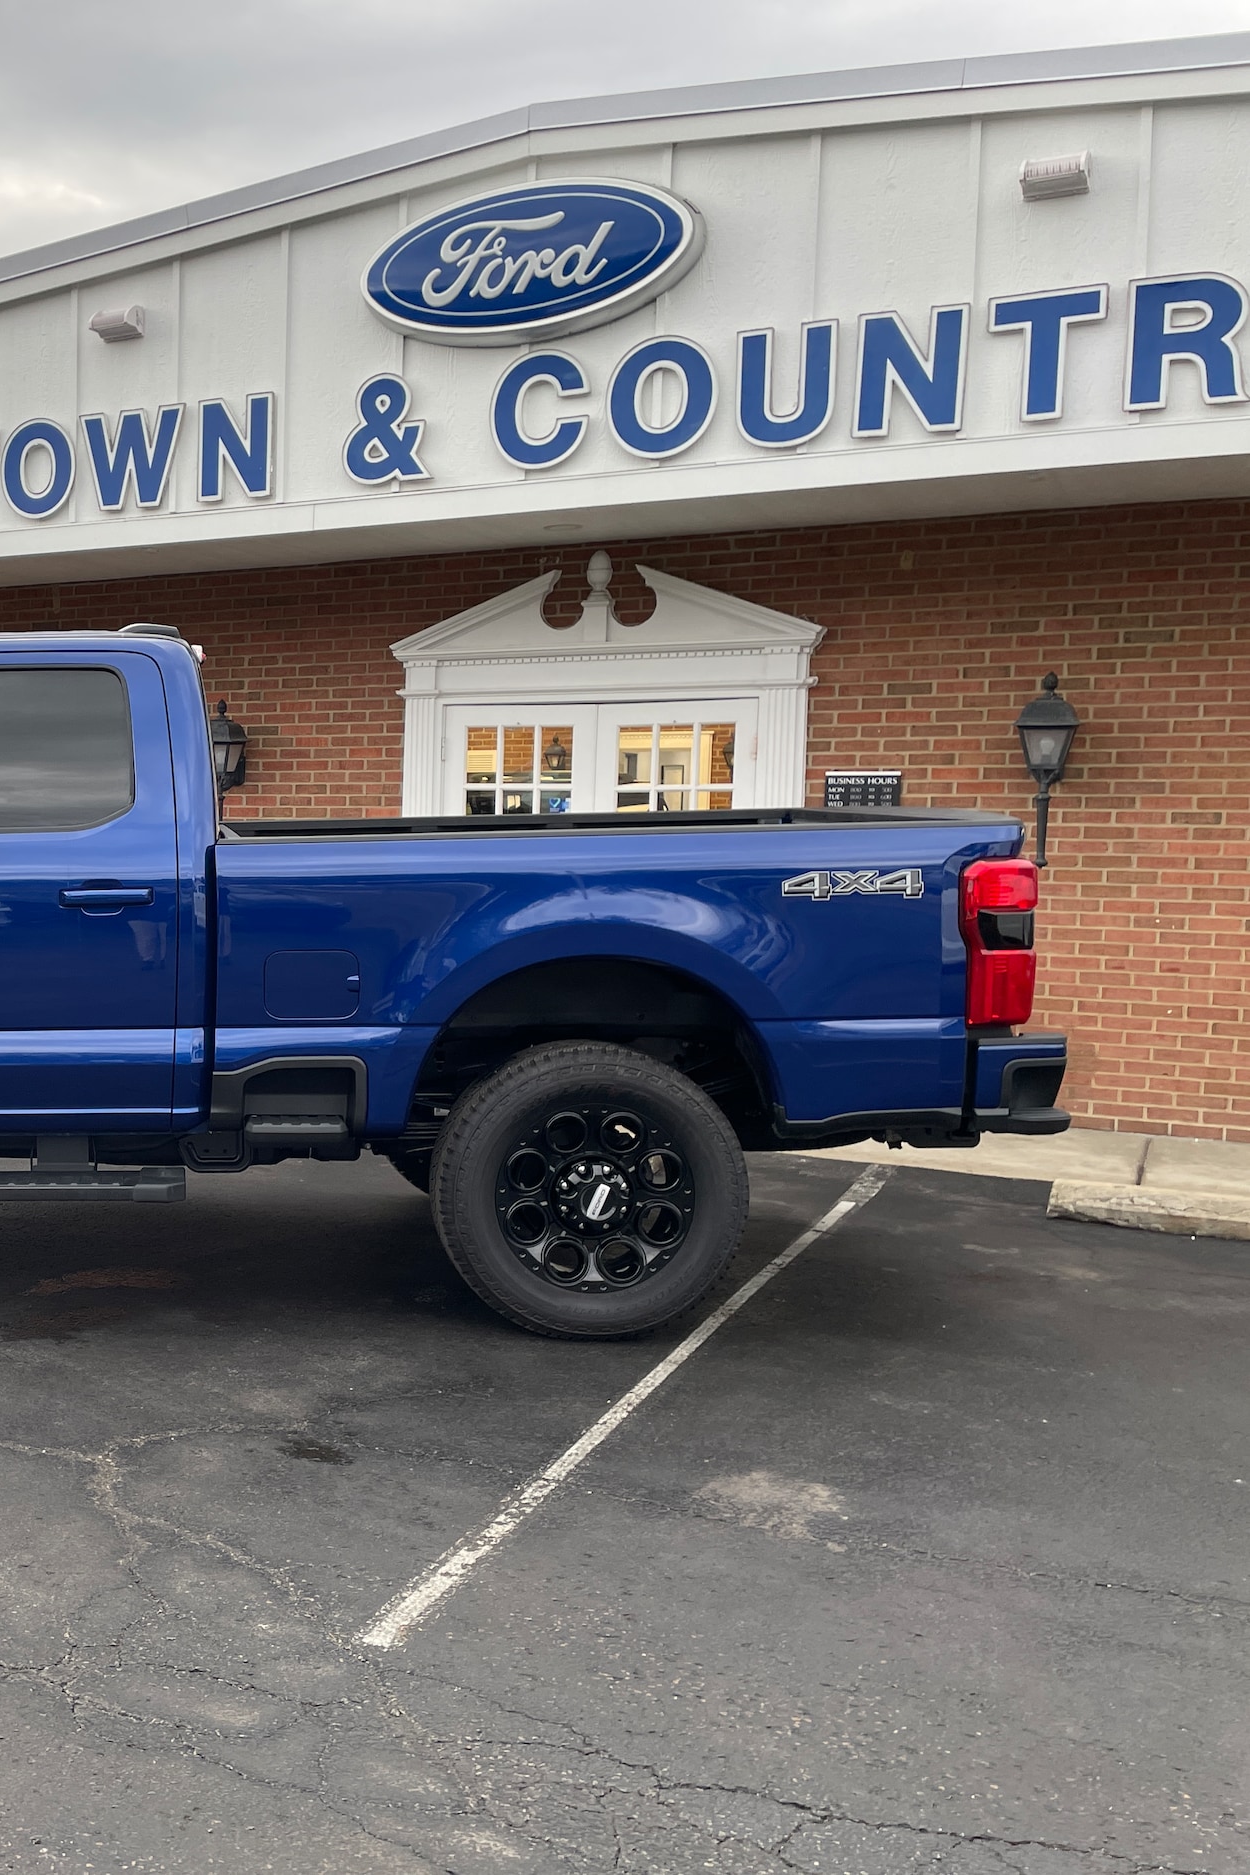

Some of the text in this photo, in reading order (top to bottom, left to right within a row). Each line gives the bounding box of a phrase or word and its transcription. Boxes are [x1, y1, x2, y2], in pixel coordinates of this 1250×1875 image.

[421, 210, 615, 308] Ford
[343, 372, 433, 486] &
[490, 271, 1250, 470] COUNTR
[827, 777, 898, 785] BUSINESS HOURS
